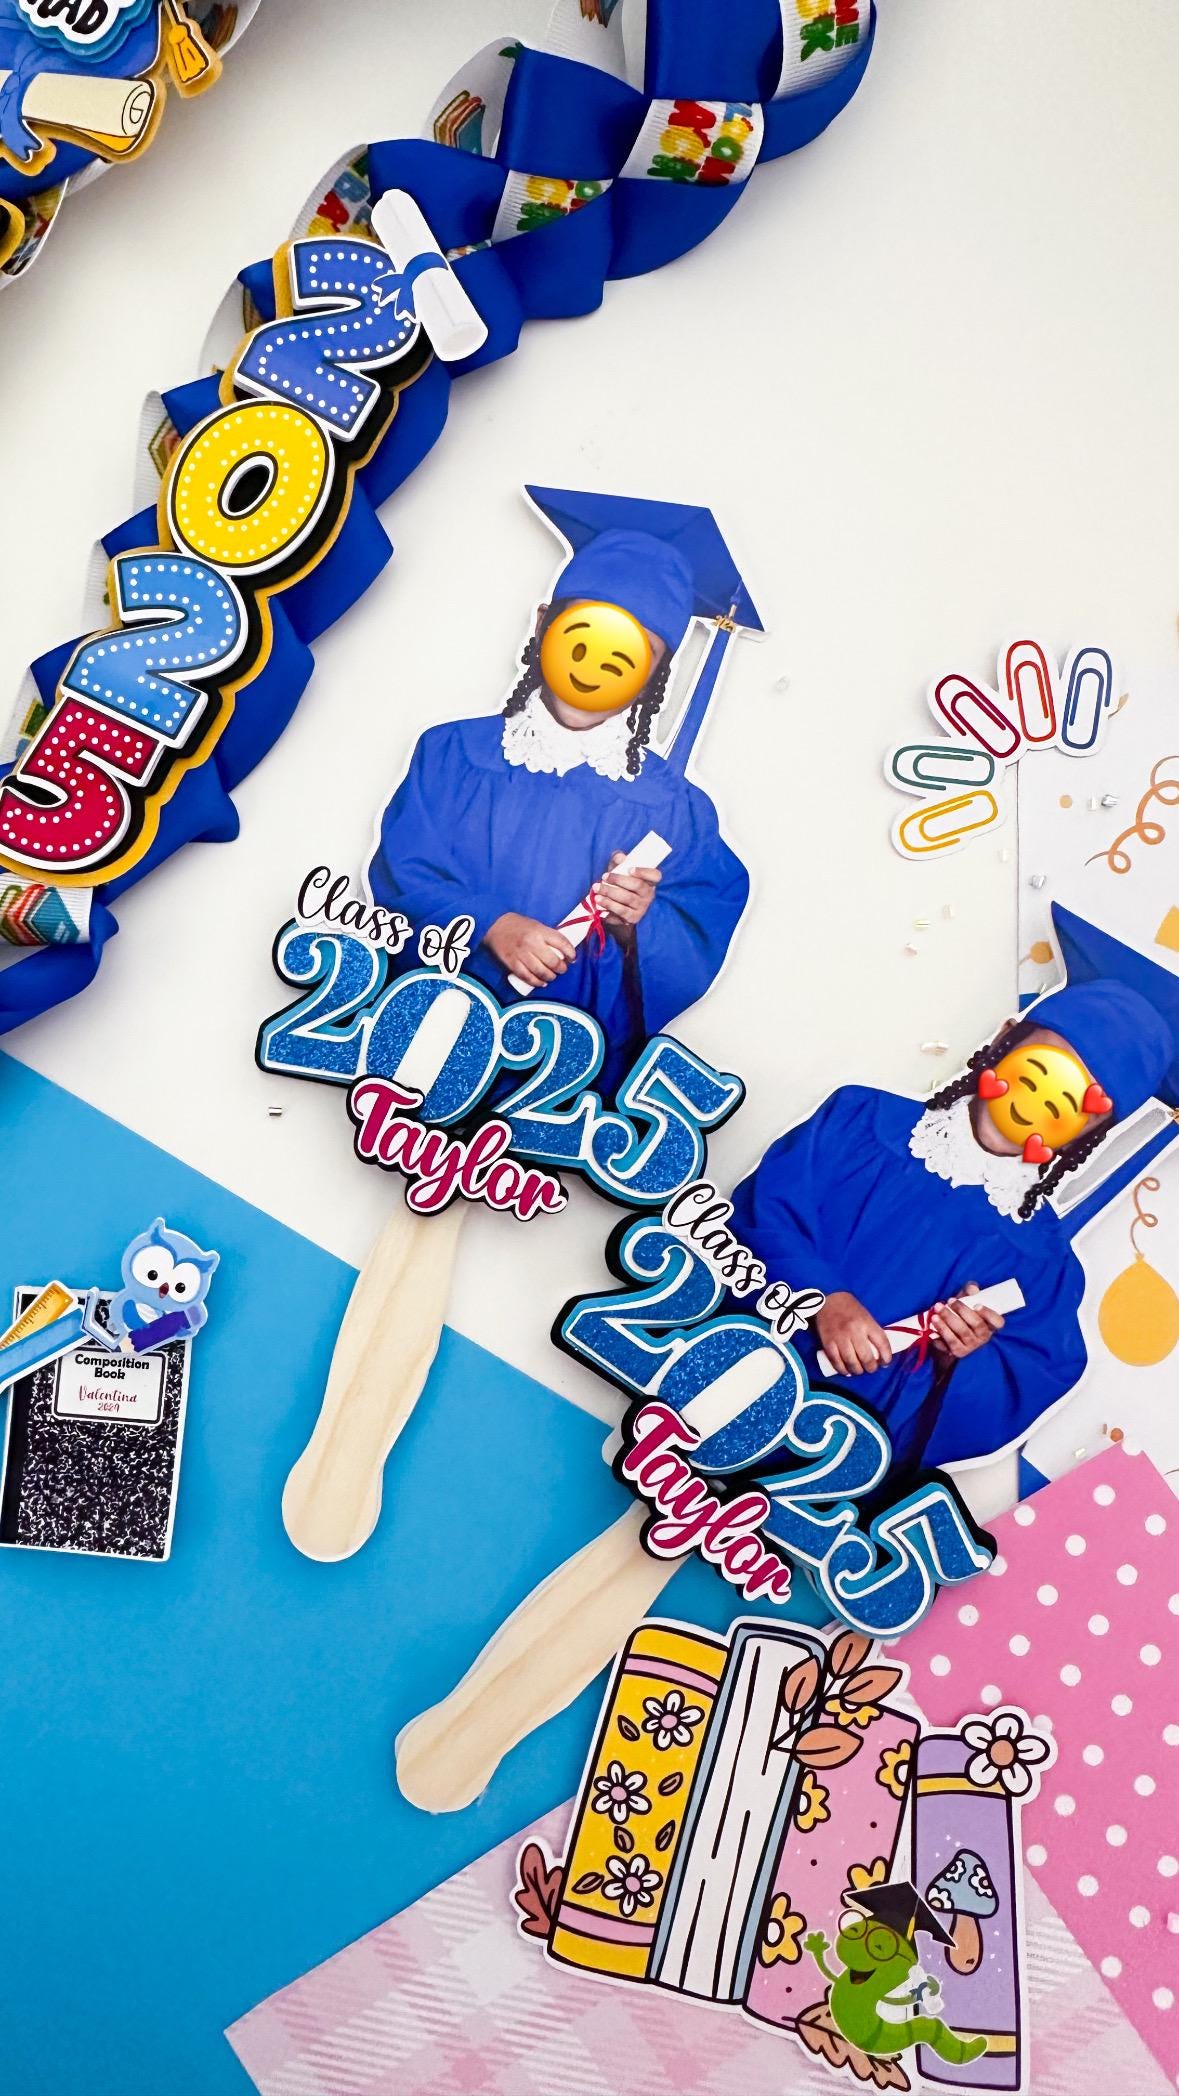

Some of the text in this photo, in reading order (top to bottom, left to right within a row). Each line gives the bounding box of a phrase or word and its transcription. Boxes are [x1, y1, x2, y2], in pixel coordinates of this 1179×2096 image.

[0, 237, 420, 869] 2025
[298, 865, 470, 973] Class of
[262, 931, 742, 1200] 2025
[353, 1082, 566, 1216] Taylor
[667, 1182, 823, 1337] Class of
[75, 1353, 150, 1370] Composition
[79, 1384, 137, 1403] Valentina
[94, 1367, 126, 1380] Book
[565, 1225, 991, 1635] 2025
[623, 1405, 790, 1600] Taylor
